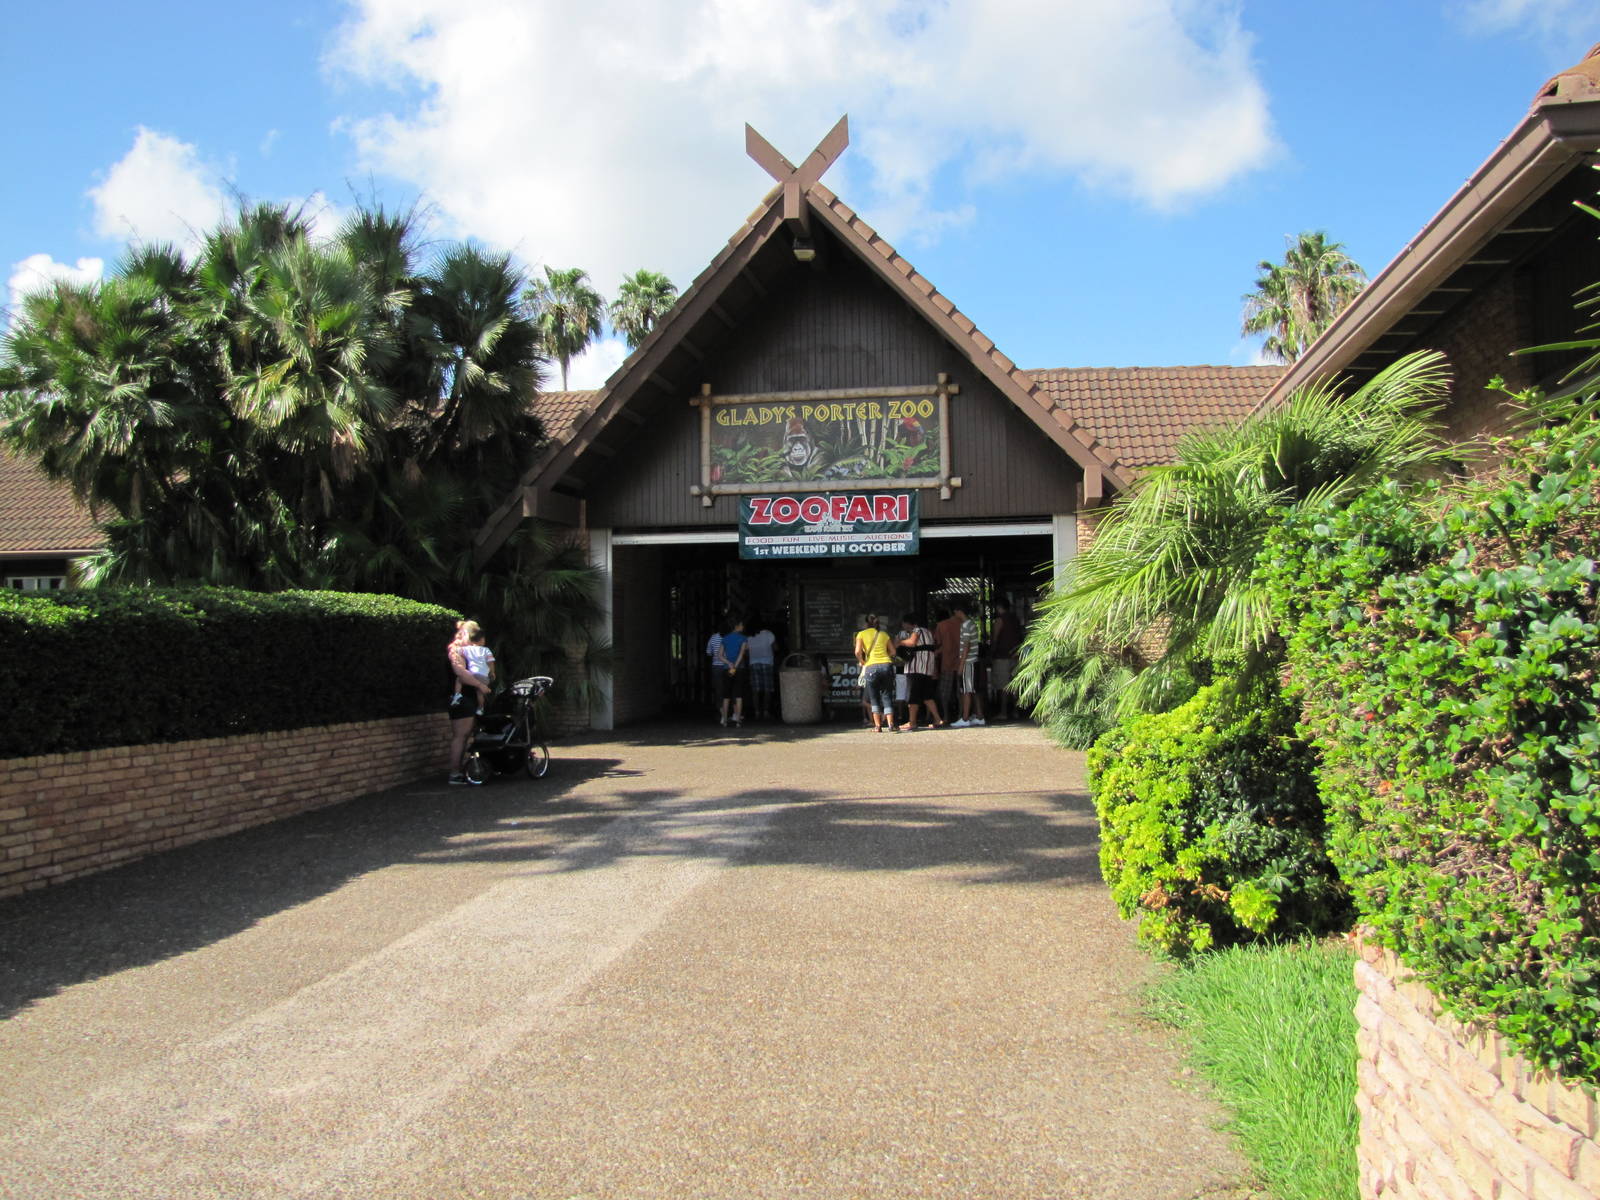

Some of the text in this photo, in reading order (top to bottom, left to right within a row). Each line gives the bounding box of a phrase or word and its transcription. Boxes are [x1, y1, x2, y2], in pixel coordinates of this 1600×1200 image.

[716, 400, 934, 426] GLADYS PORTER ZOO
[748, 494, 909, 525] ZOOFARI
[864, 533, 911, 541] AUCTIONS
[771, 544, 829, 555] WEEKEND
[831, 544, 846, 553] IN
[848, 542, 906, 553] OCTOBER
